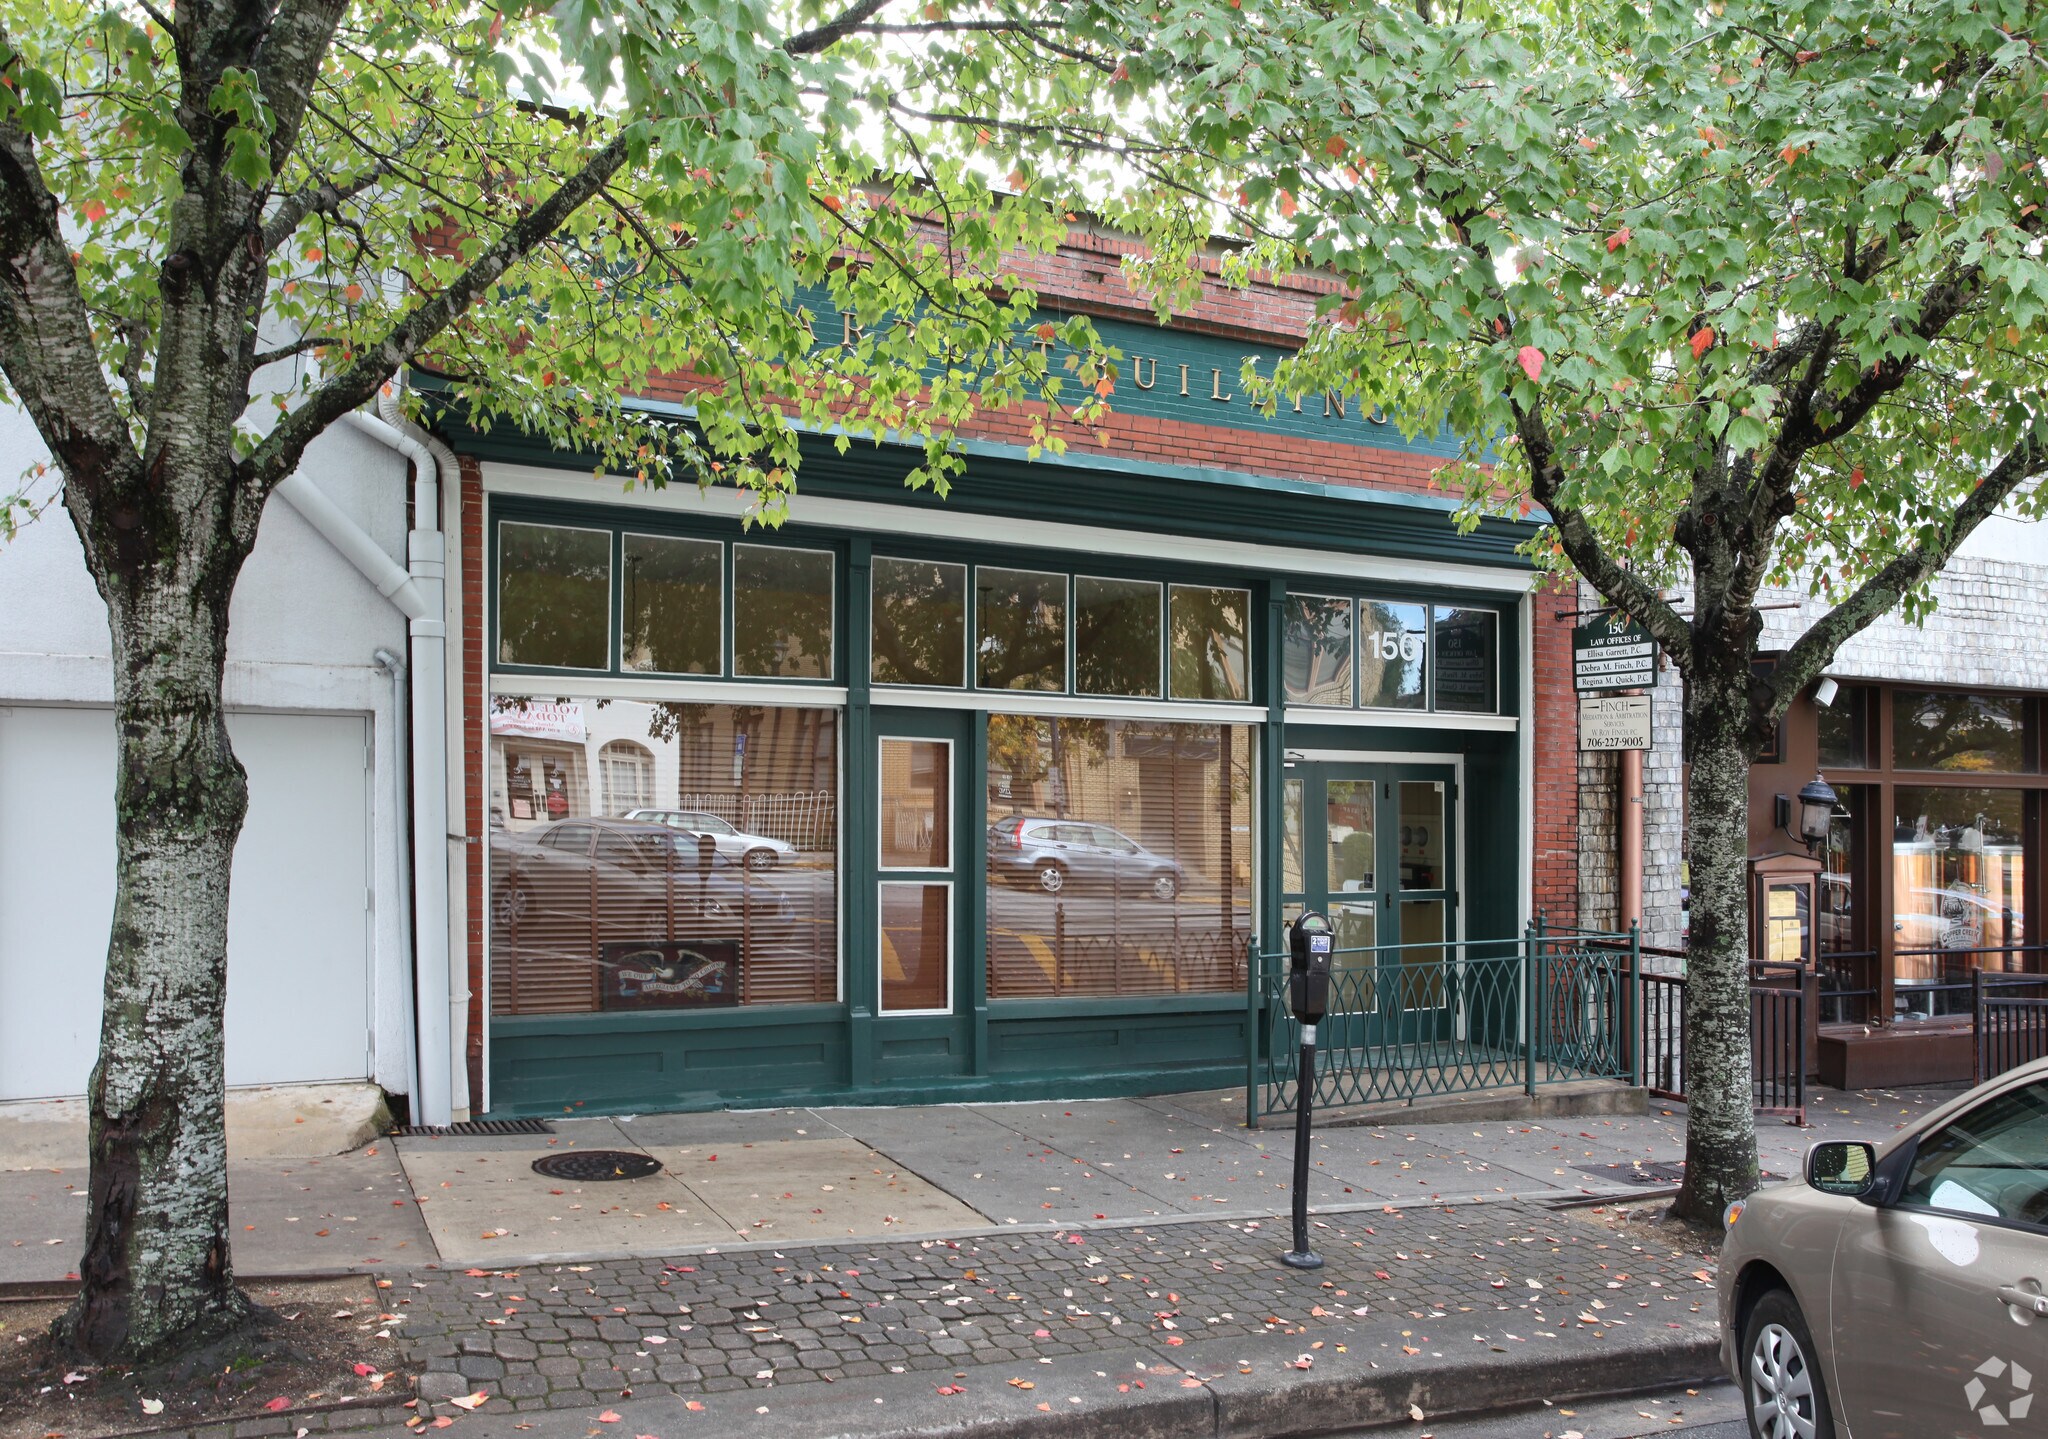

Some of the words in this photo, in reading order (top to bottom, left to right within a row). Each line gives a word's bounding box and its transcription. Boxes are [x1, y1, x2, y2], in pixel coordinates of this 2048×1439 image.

[1608, 621, 1624, 635] 150
[1369, 630, 1416, 662] 150
[1590, 638, 1605, 646] LAW
[1607, 635, 1631, 645] OFFICES
[1633, 634, 1642, 642] OF
[1587, 650, 1603, 658] Ellisa
[1581, 664, 1600, 672] Debra
[1614, 661, 1634, 669] Finch,
[1635, 660, 1648, 668] P.C.
[1582, 678, 1603, 686] Regina
[1615, 675, 1635, 684] Quick,
[1637, 674, 1649, 682] P.C.
[1600, 700, 1629, 712] FINCH
[1587, 736, 1644, 748] 706-227-9005
